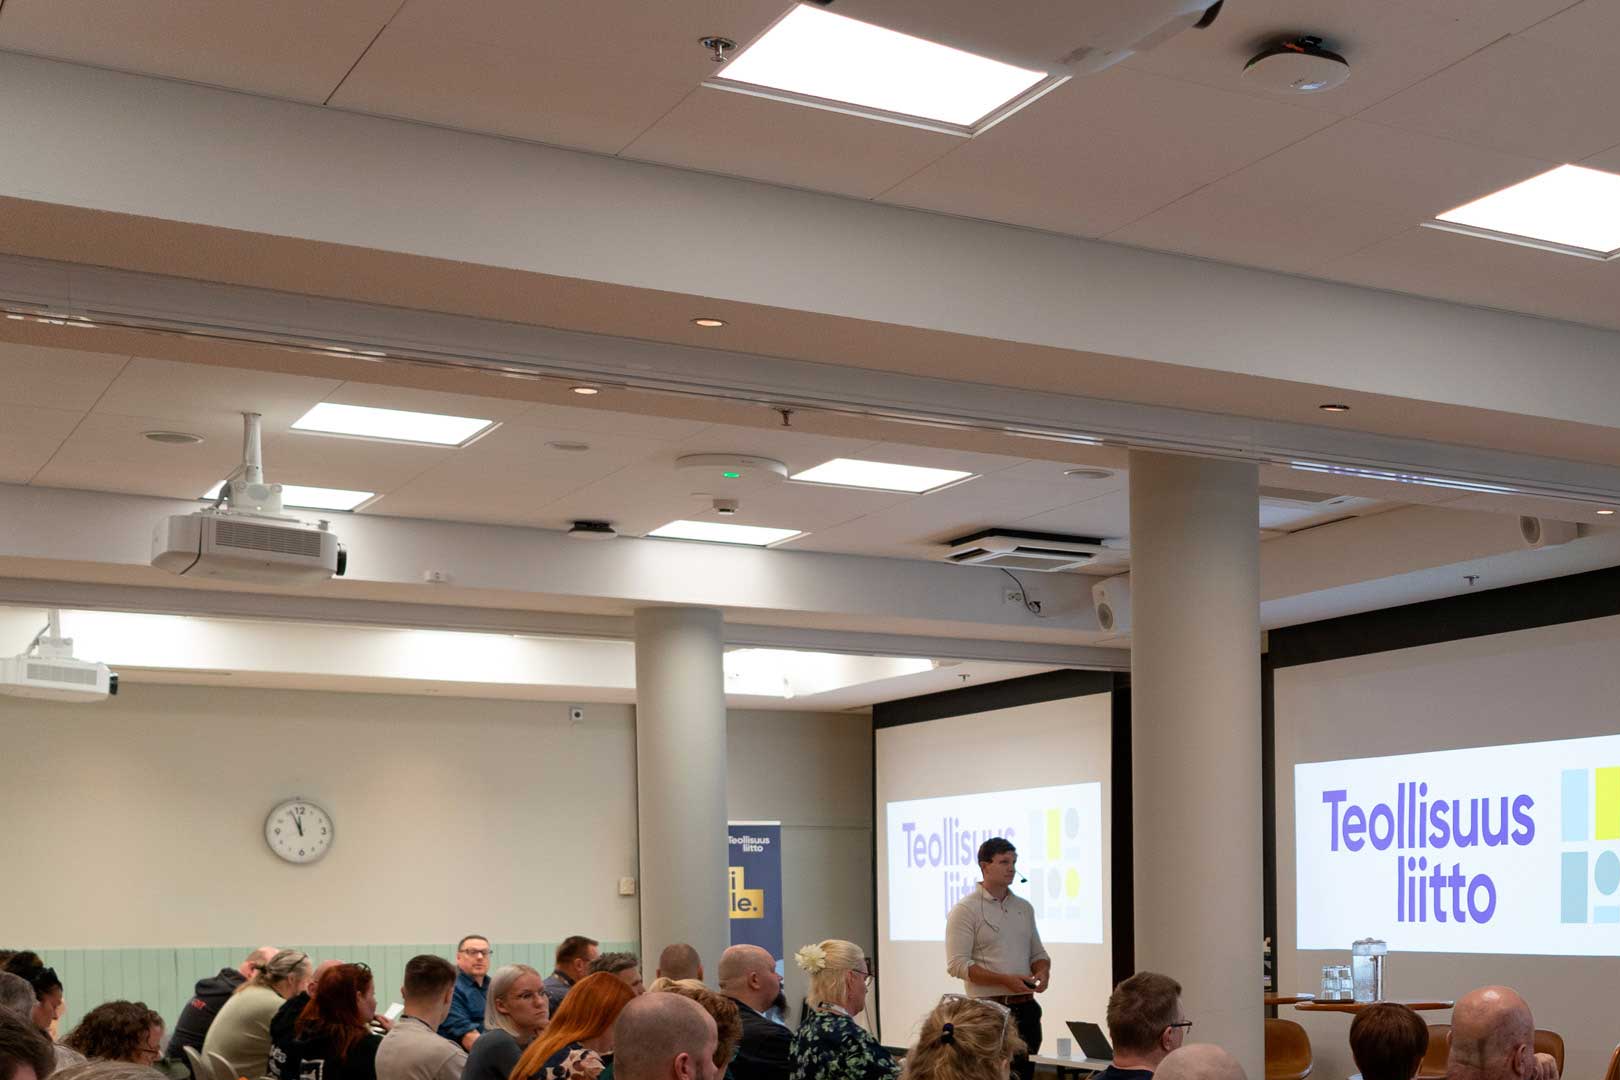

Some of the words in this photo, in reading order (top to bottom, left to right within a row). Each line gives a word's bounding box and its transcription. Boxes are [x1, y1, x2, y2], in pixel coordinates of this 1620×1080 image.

[901, 816, 1016, 869] Teollisu
[1322, 781, 1536, 852] Teollisuus
[1397, 855, 1497, 925] liitto
